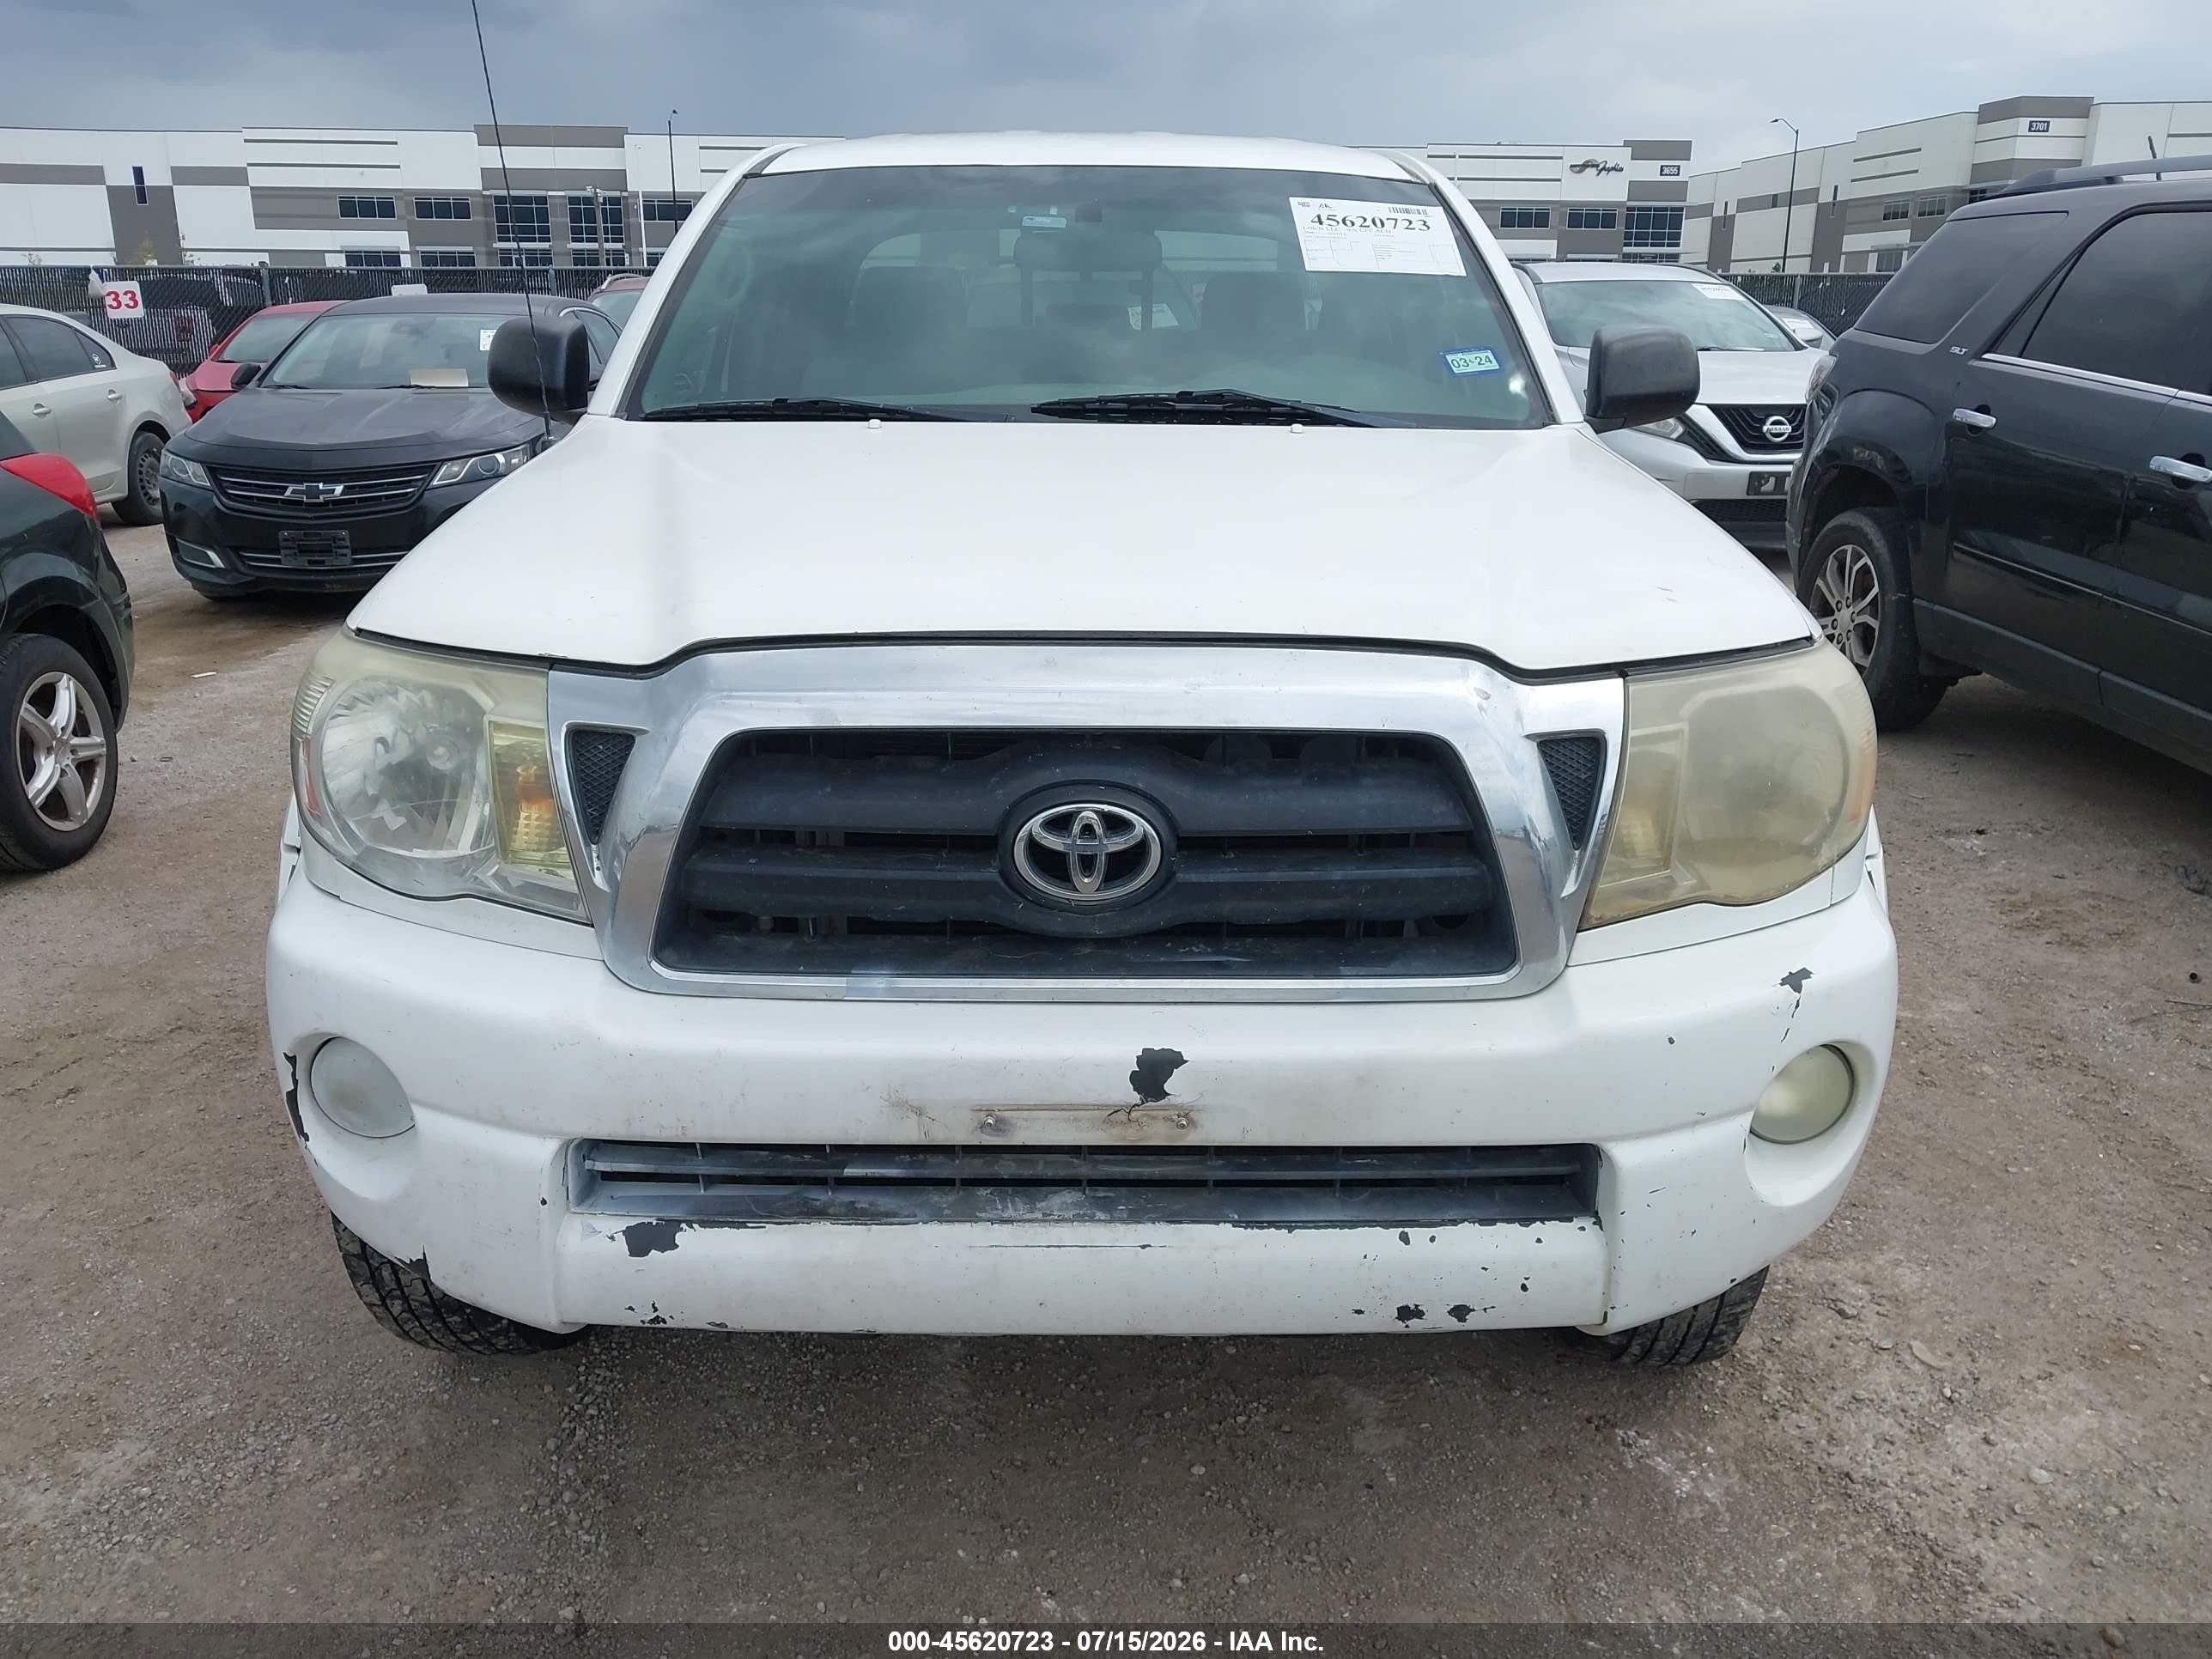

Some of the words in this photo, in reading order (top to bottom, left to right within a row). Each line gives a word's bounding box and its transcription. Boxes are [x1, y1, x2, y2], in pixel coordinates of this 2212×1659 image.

[2031, 122, 2048, 131] 3701
[1310, 213, 1431, 232] 45620723
[105, 290, 139, 310] 33
[1949, 346, 1968, 356] SLT
